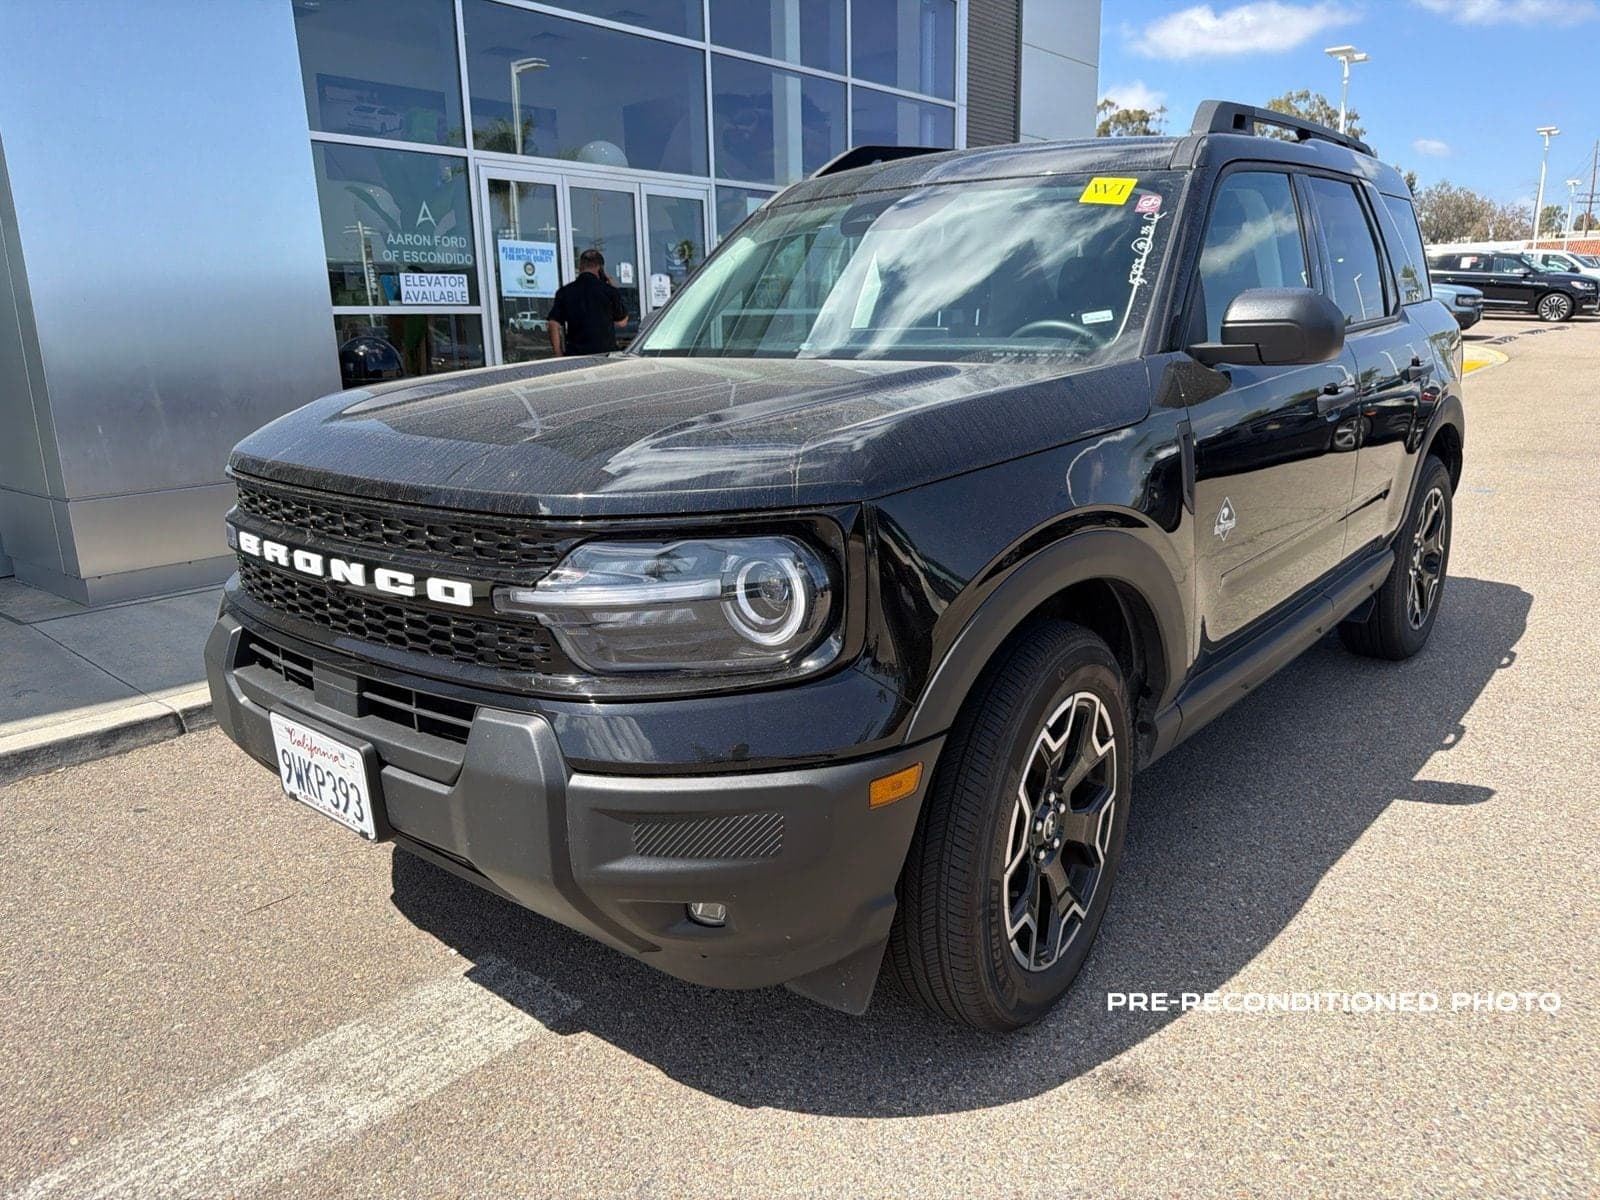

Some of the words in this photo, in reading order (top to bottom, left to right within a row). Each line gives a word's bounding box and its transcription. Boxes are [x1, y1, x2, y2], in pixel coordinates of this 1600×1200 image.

[387, 233, 431, 247] AARON
[435, 236, 467, 248] FORD
[382, 250, 400, 262] OF
[403, 251, 474, 265] ESCONDIDO
[404, 275, 465, 288] ELEVATOR
[404, 291, 468, 303] AVAILABLE
[239, 531, 473, 607] BRONCO
[288, 727, 347, 769] California
[281, 748, 364, 822] 9WKP393
